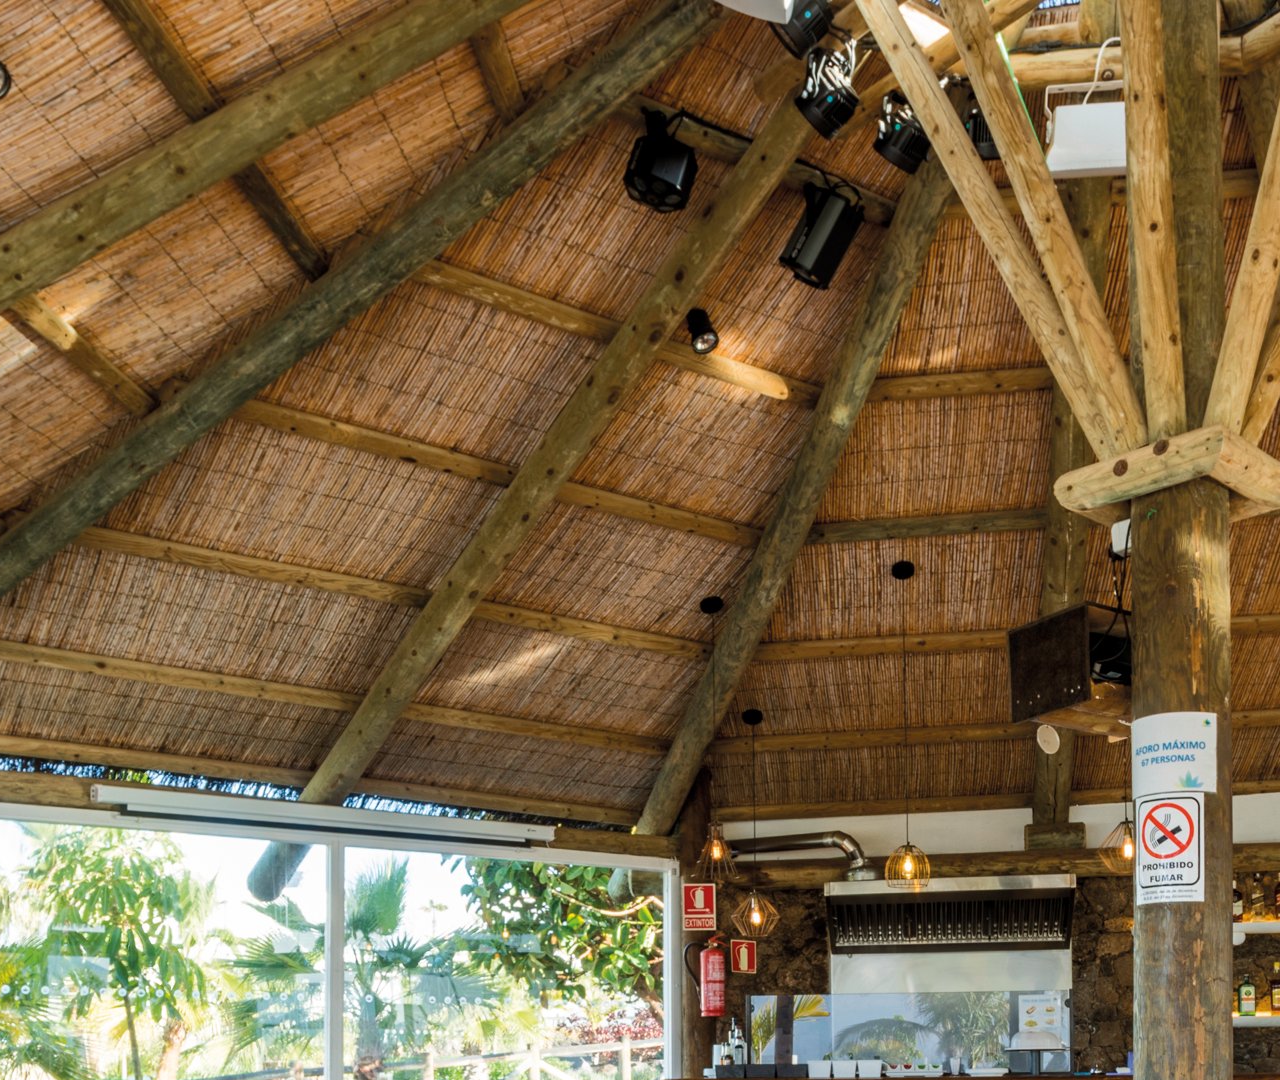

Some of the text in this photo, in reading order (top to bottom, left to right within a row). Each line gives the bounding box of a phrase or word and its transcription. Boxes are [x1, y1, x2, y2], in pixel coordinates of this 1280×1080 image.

[1135, 739, 1206, 756] AFORO MÁXIMO
[1150, 754, 1196, 765] PERSONAS
[1142, 861, 1194, 872] PROHIBIDO
[1149, 873, 1184, 883] FUMAR
[684, 918, 714, 928] EXTINTOR
